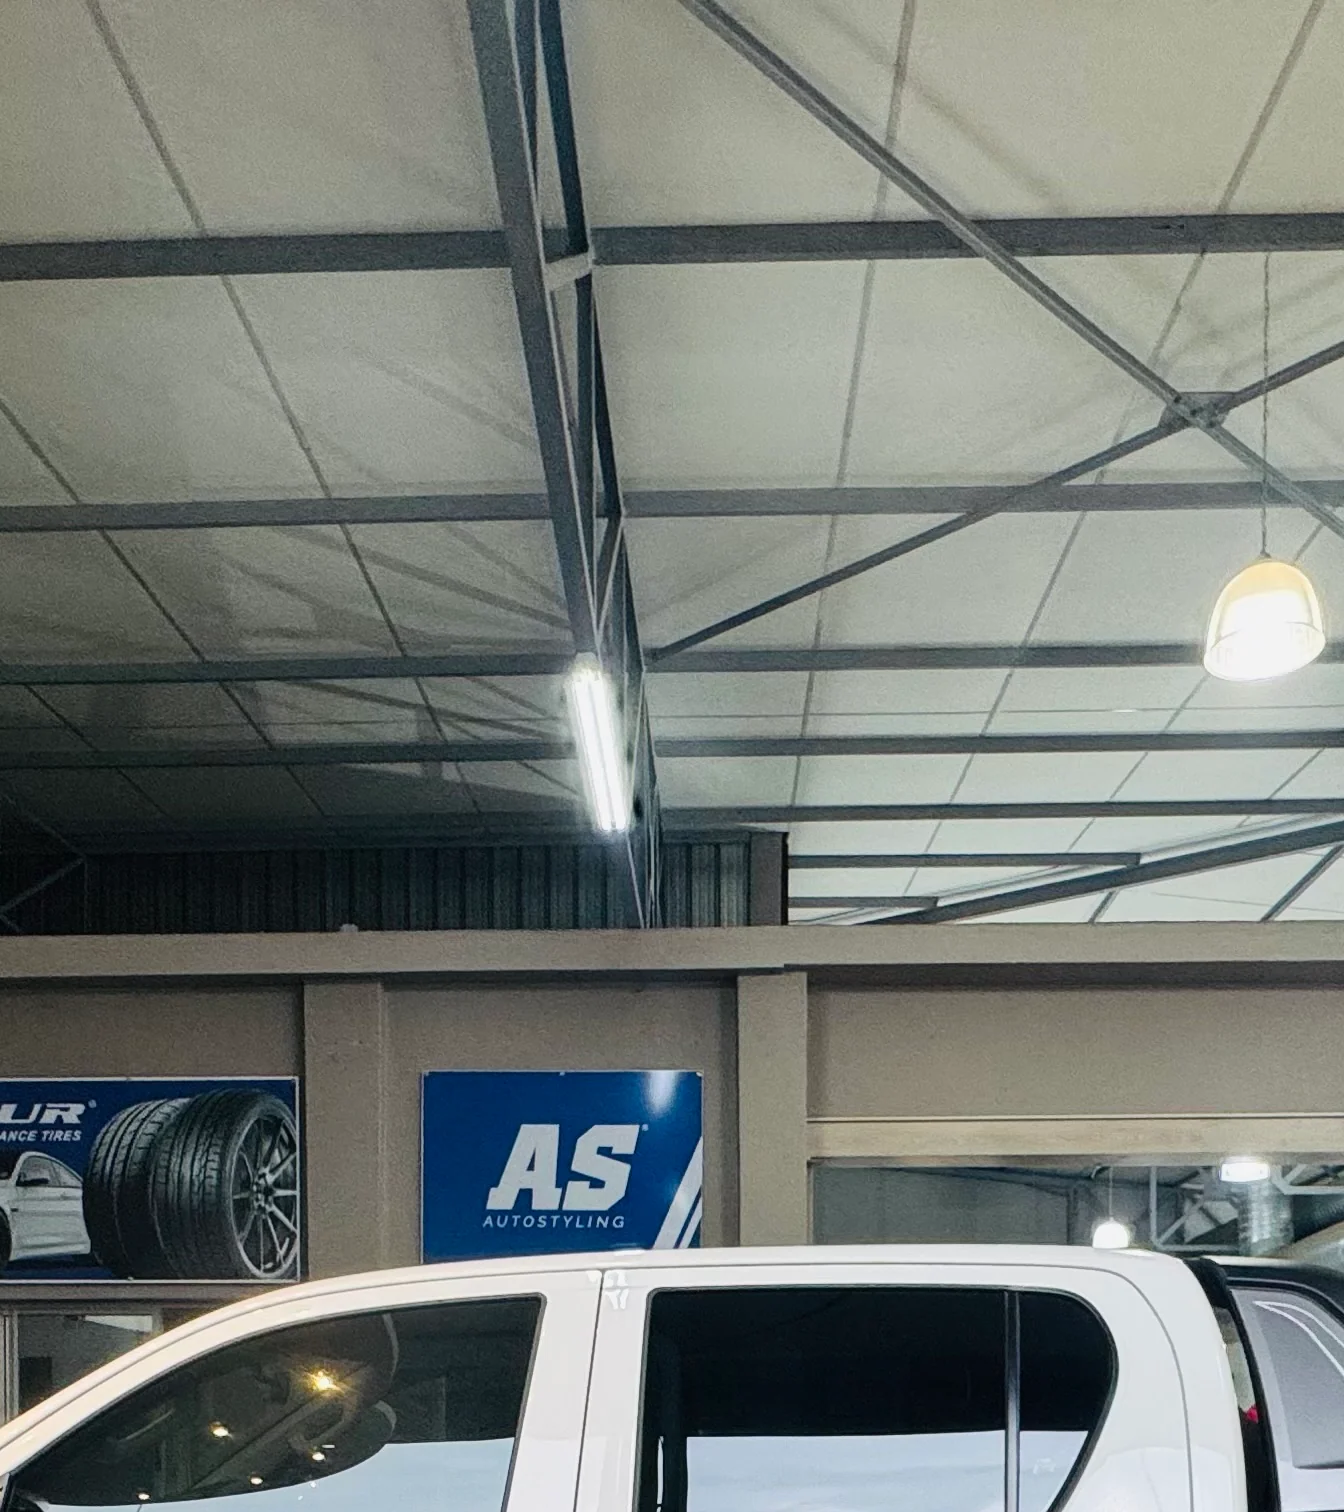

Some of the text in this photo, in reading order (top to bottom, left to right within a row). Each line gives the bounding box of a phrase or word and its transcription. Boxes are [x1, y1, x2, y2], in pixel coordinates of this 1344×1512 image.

[40, 1130, 82, 1142] TIRES
[486, 1123, 641, 1211] AS
[482, 1215, 625, 1228] AUTOSTYLING
